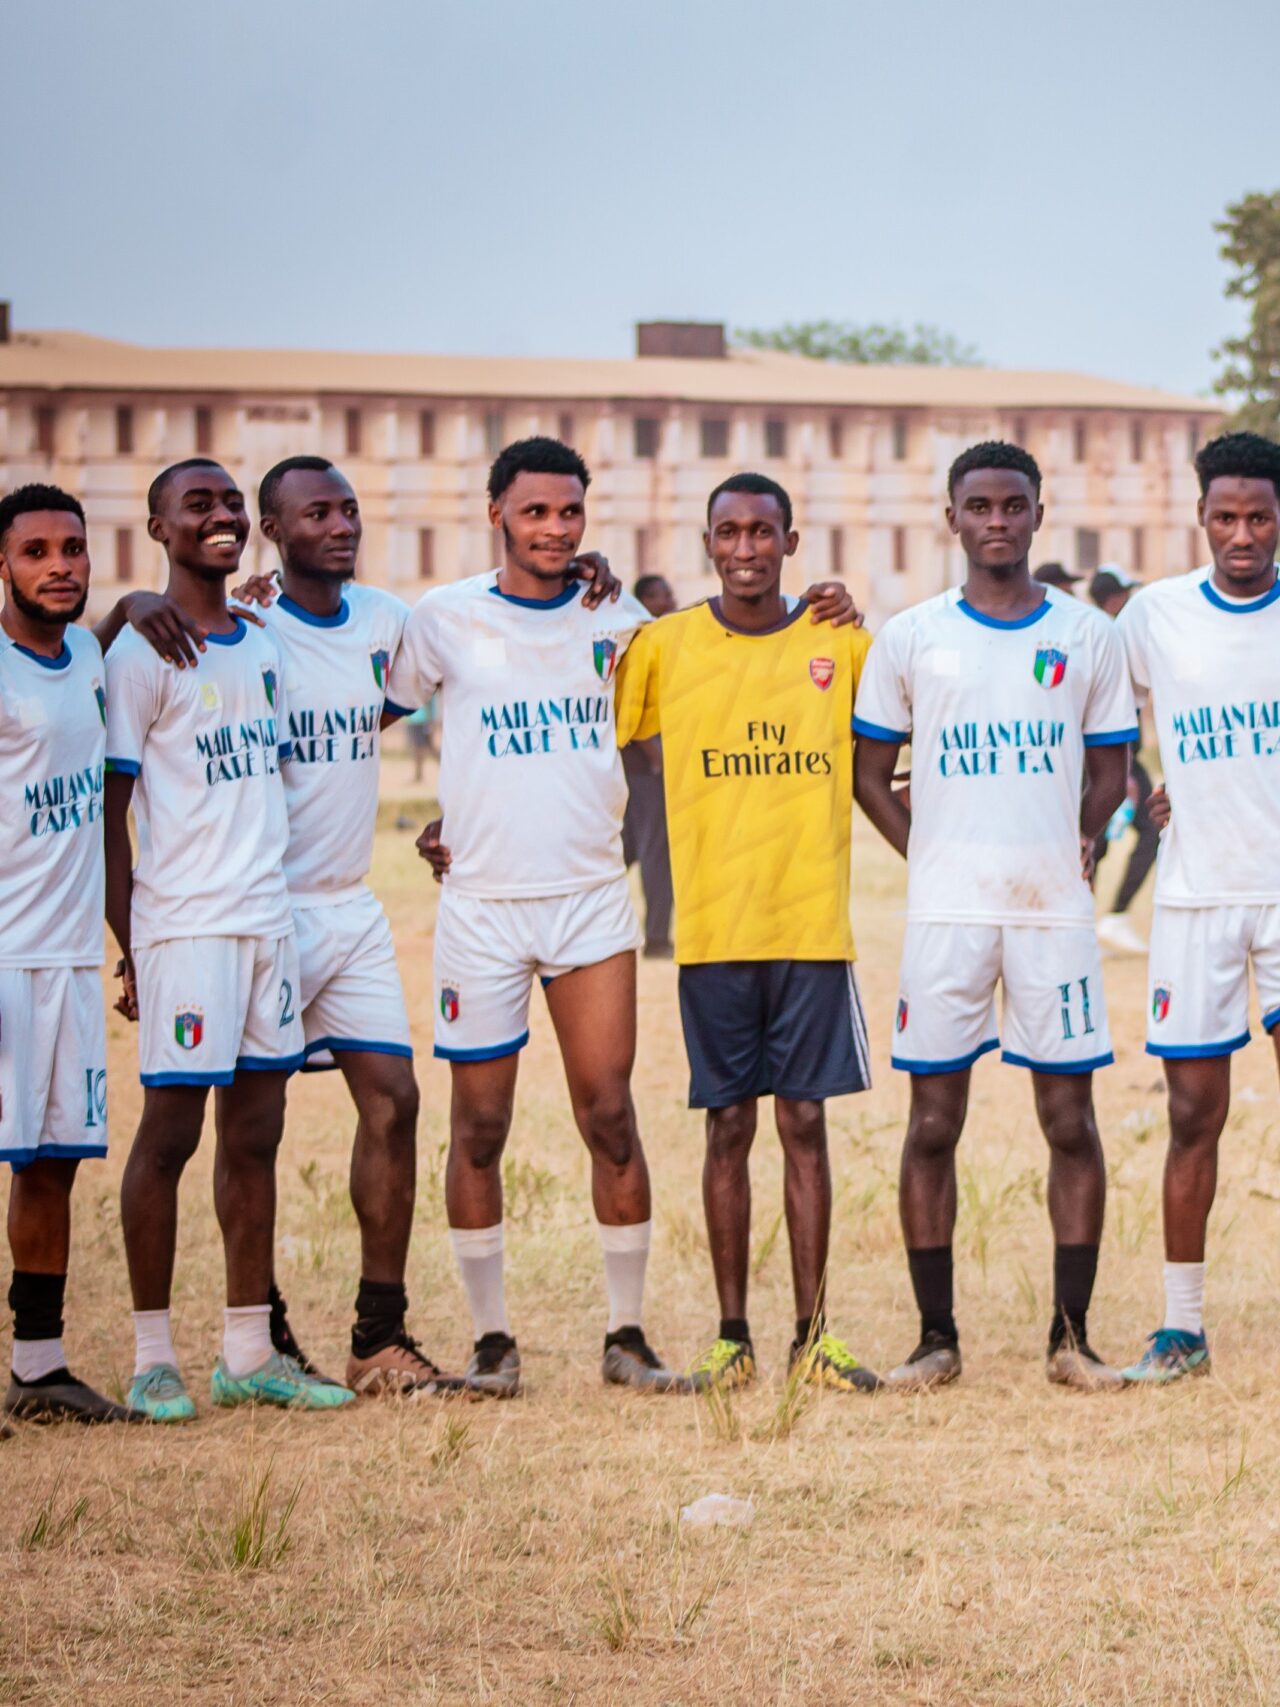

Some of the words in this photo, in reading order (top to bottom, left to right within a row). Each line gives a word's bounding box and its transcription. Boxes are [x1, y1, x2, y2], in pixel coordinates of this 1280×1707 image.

[488, 728, 557, 758] CARE
[747, 720, 786, 746] Fly
[1178, 732, 1240, 764] CARE
[206, 751, 260, 786] CARE
[702, 746, 831, 778] Emirates
[938, 751, 1005, 778] CARE
[1019, 750, 1054, 775] F.A
[279, 978, 295, 1029] 2
[1057, 976, 1095, 1040] 11
